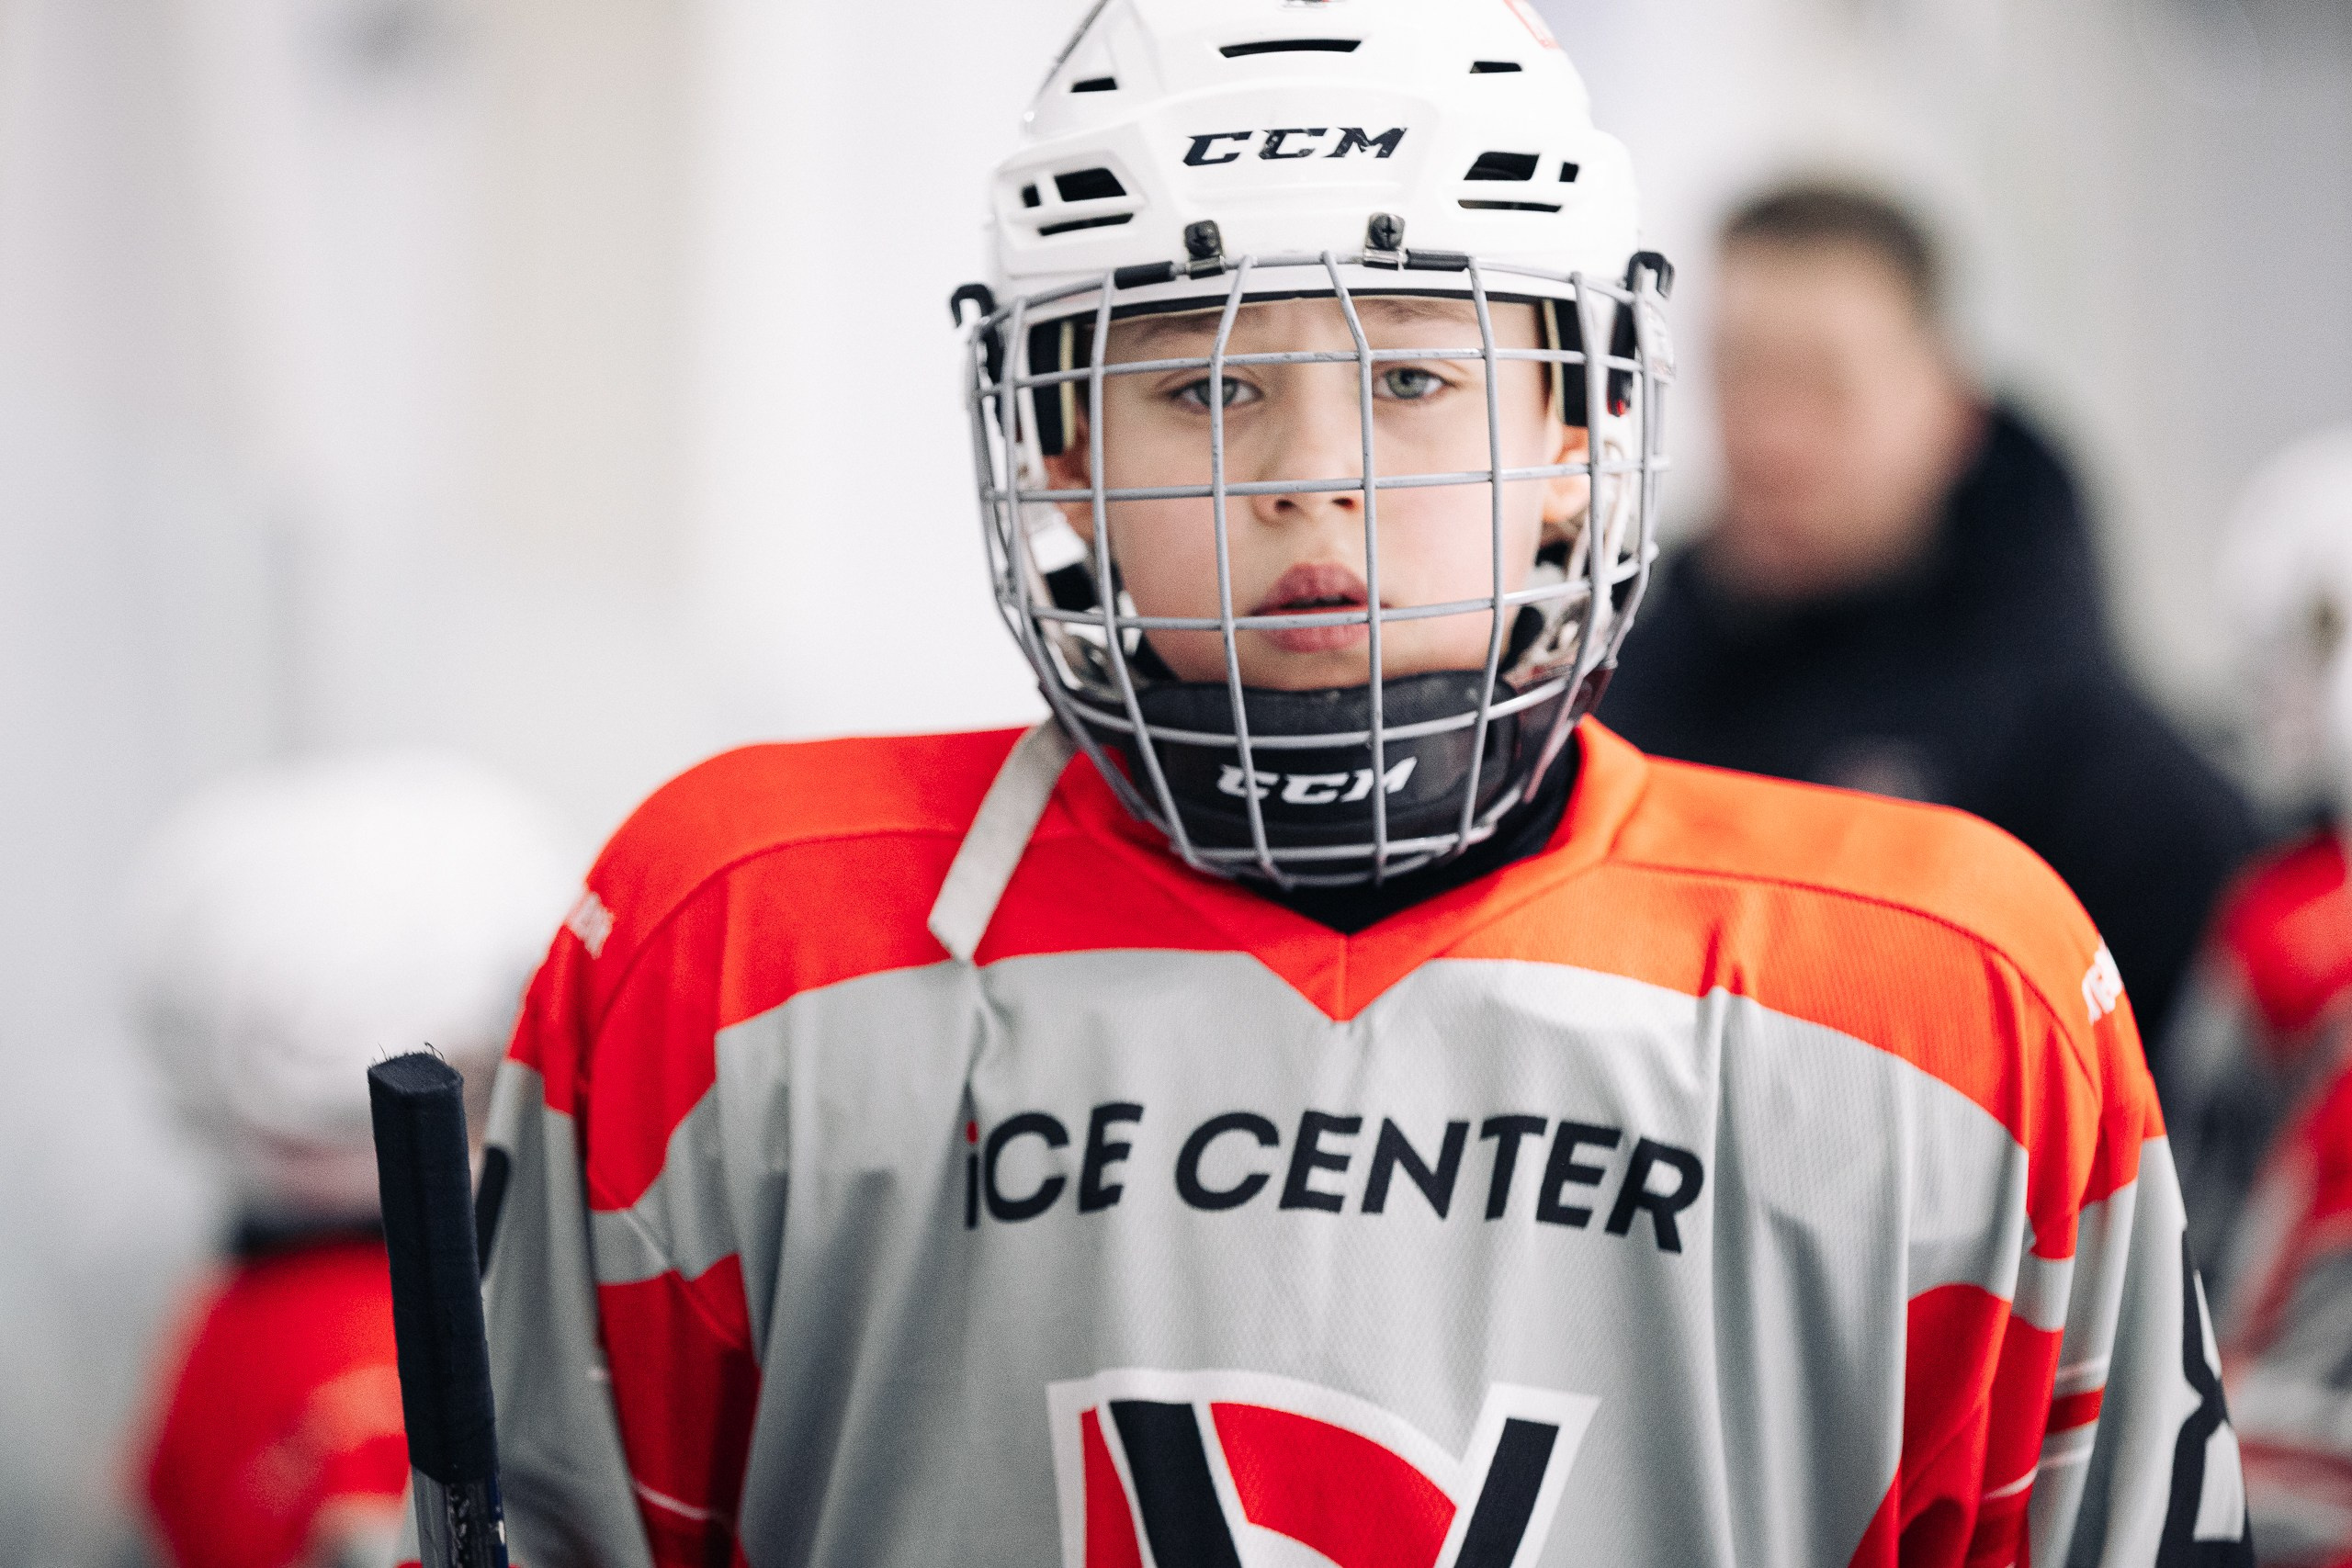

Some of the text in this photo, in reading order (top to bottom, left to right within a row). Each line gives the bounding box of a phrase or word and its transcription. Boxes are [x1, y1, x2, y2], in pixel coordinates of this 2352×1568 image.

[1182, 126, 1408, 167] CCM
[1216, 755, 1418, 805] CCM
[1173, 1111, 1706, 1255] CENTER
